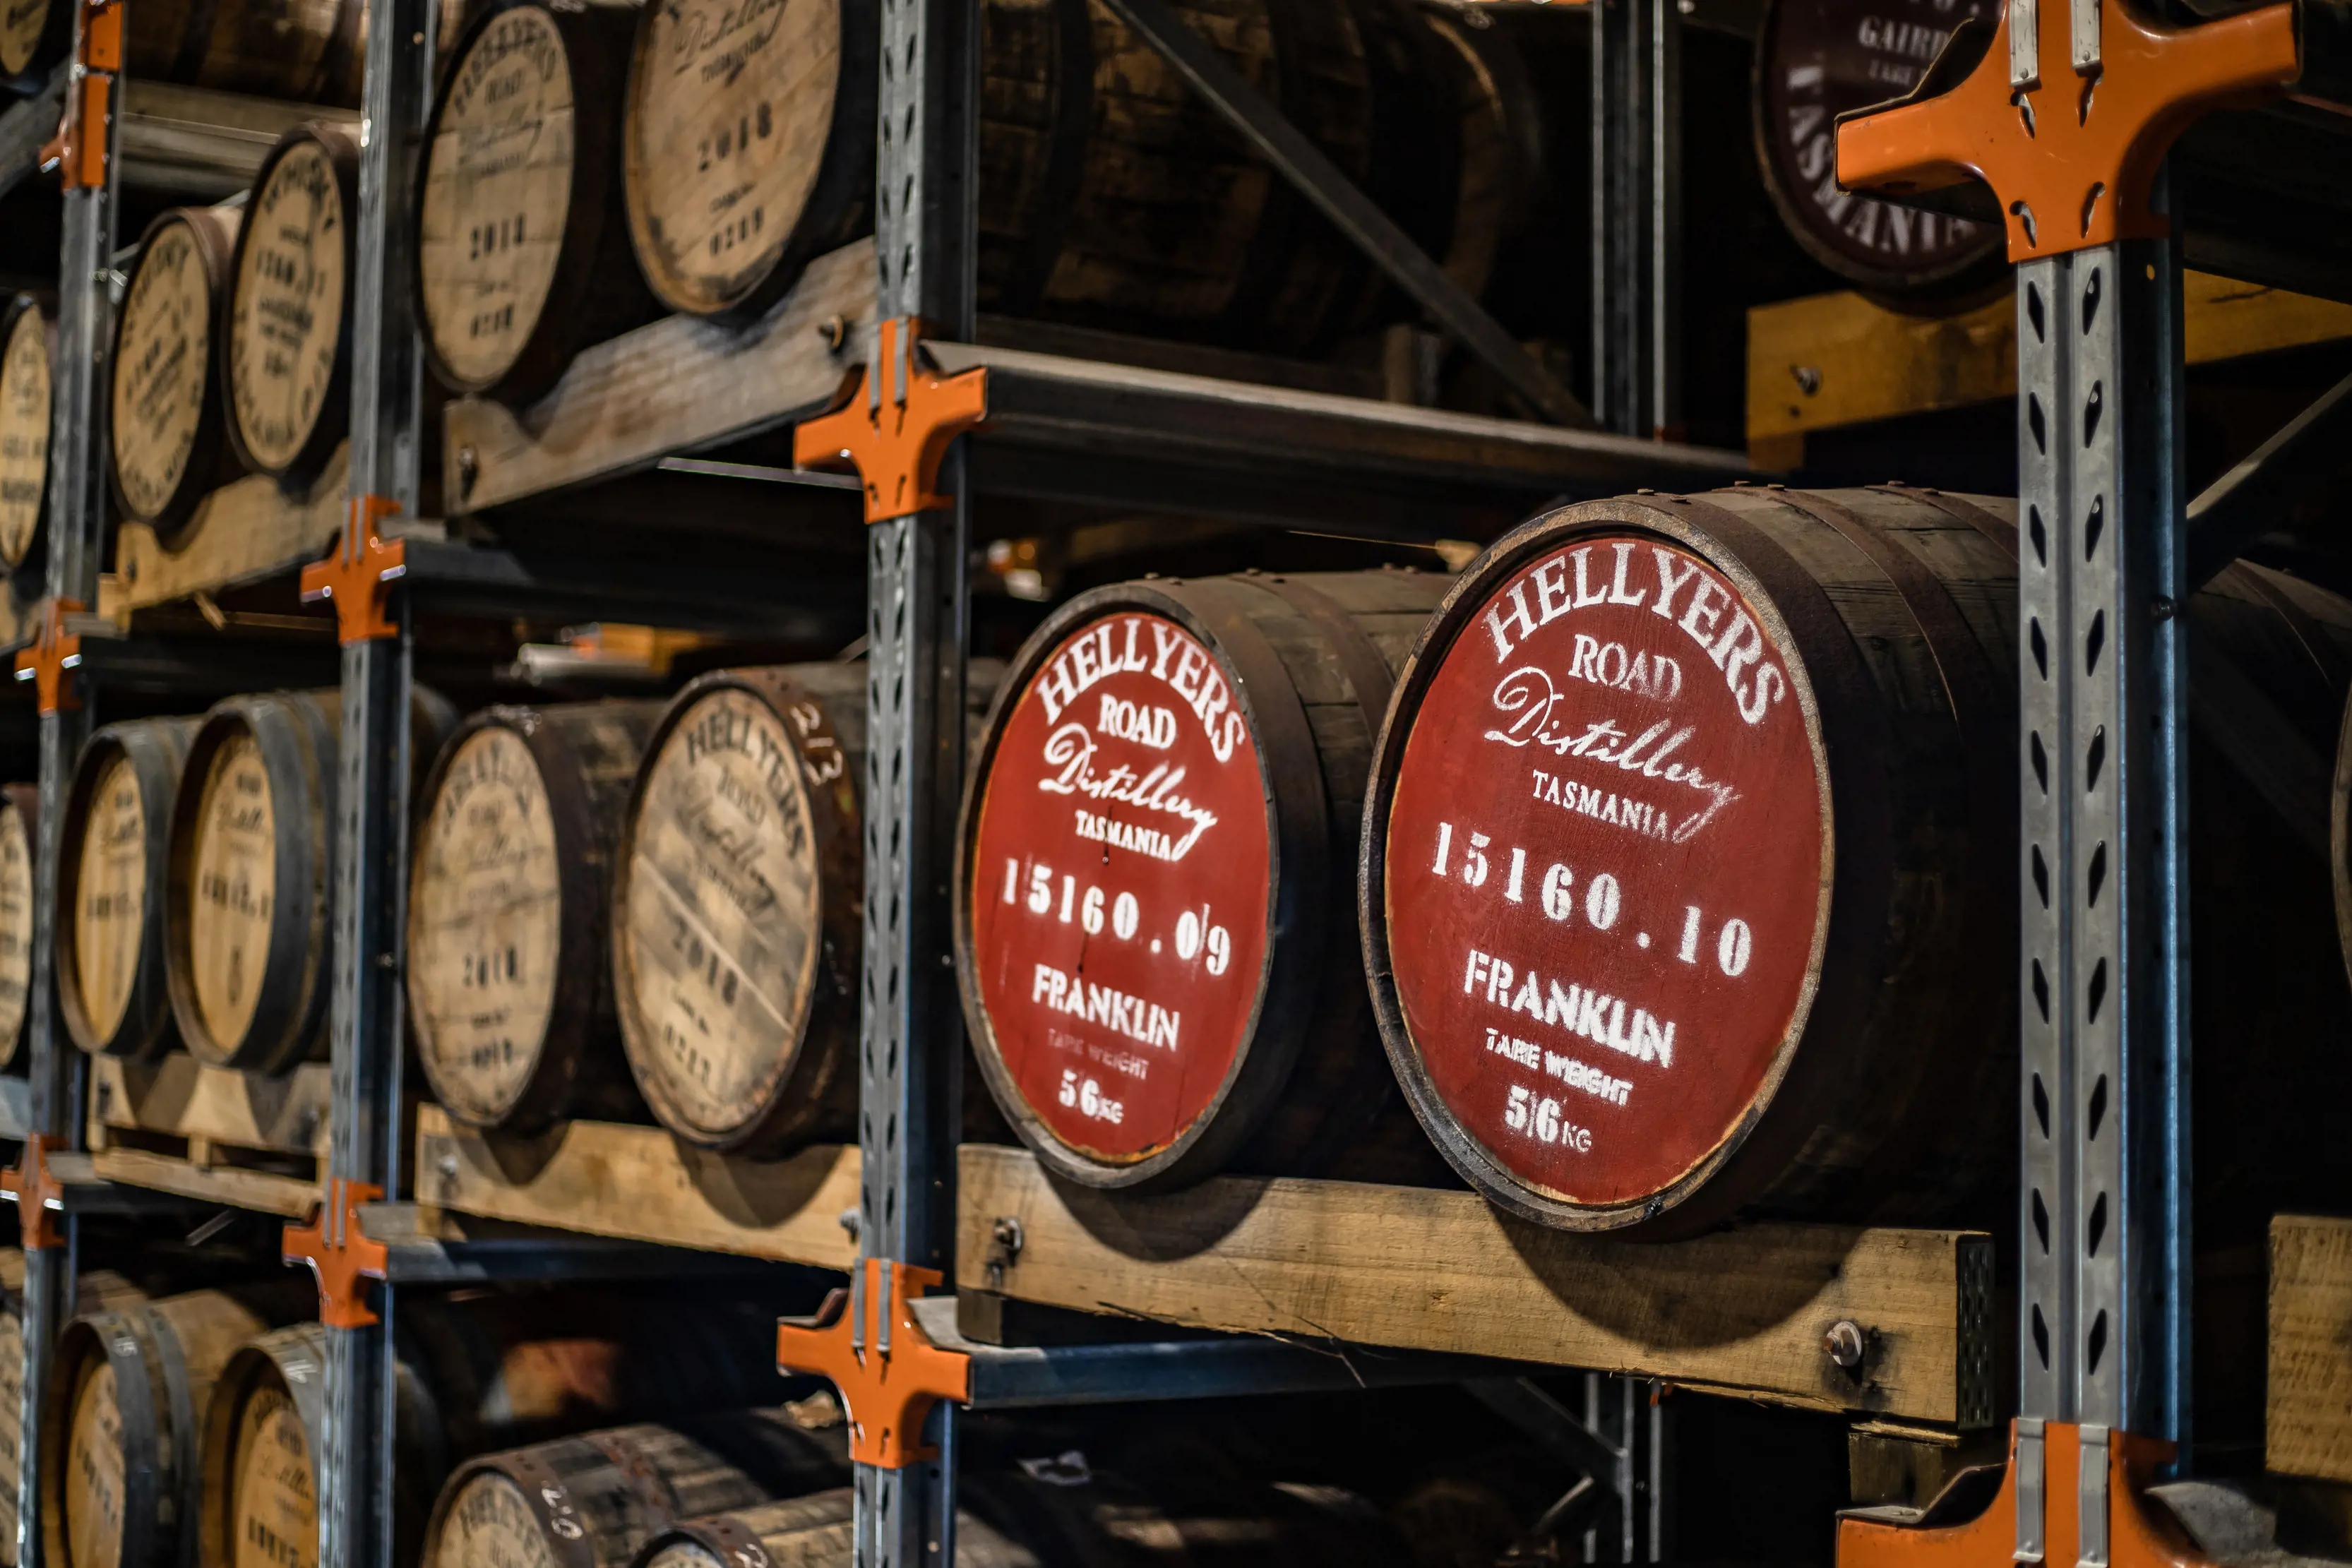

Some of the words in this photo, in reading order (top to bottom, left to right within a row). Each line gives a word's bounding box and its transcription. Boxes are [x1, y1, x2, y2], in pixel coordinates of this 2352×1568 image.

[1482, 542, 1785, 726] HELLYERS
[1568, 633, 1682, 701] ROAD
[1036, 618, 1246, 763] HELLYERS
[1097, 693, 1178, 750] ROAD
[1038, 722, 1218, 862] Distillery
[1484, 666, 1743, 843] Distillery
[1532, 770, 1669, 841] TASMANIA
[1075, 809, 1171, 860] TASMANIA
[1003, 858, 1231, 977] 15160.09
[1431, 821, 1753, 977] 15160.10
[1032, 963, 1181, 1052] FRANKLIN
[1048, 1028, 1085, 1055] TARE
[1087, 1043, 1150, 1080] WEIGHT
[1464, 947, 1676, 1068] FRANKLIN
[1486, 1027, 1541, 1071] TARE
[1544, 1049, 1633, 1108] WEIGHT
